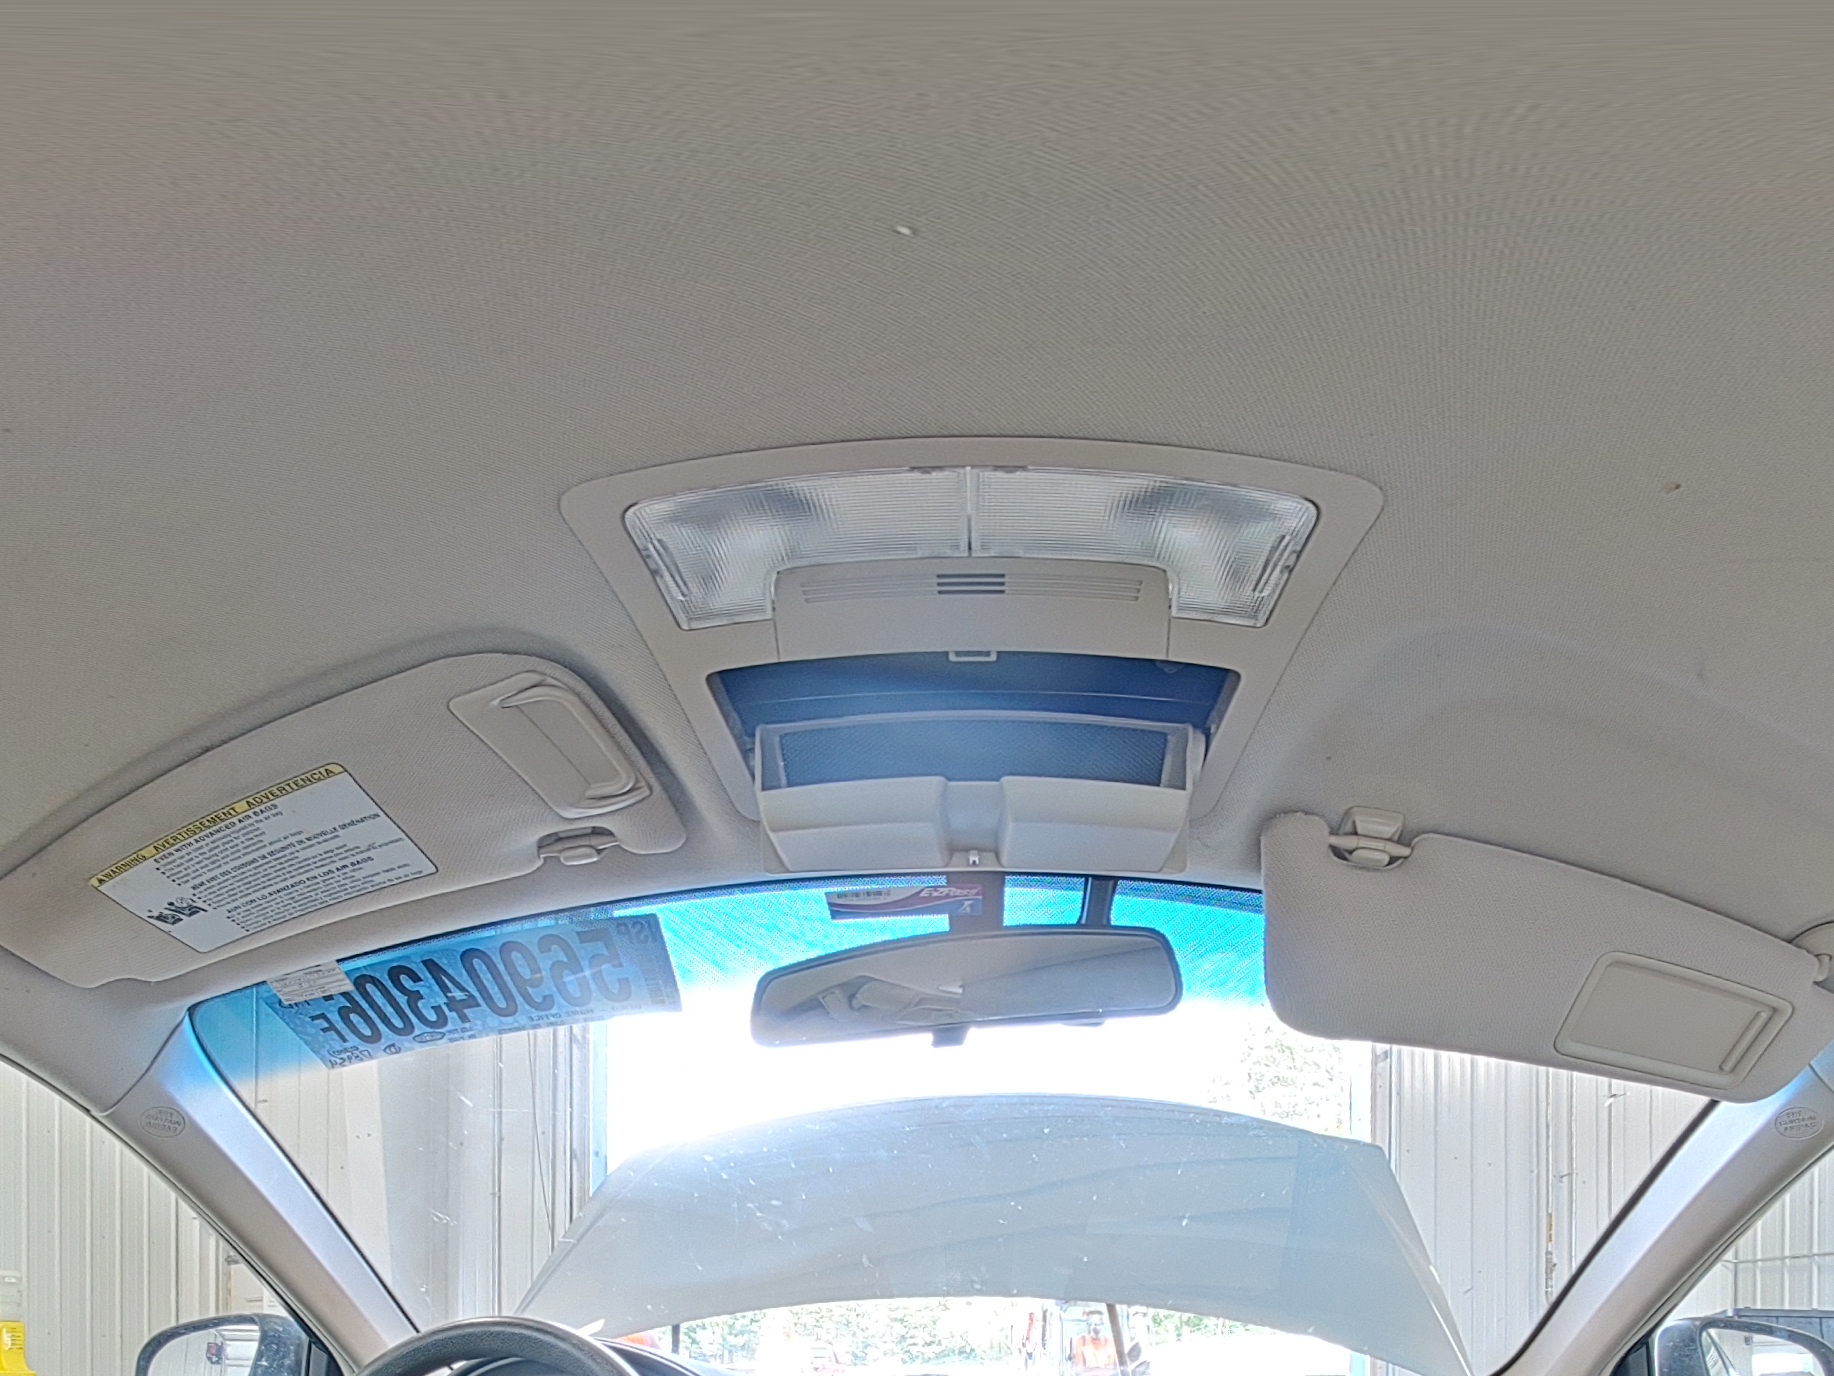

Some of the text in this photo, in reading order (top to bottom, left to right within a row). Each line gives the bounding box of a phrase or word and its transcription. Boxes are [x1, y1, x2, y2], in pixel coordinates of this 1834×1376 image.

[245, 767, 336, 808] ADVERTENCIA
[152, 806, 239, 852] AVERTISSEMENT
[153, 803, 279, 864] EVEN WITH ADVANCED AIR BAGS
[103, 853, 147, 882] WARNING
[334, 864, 350, 872] AIR
